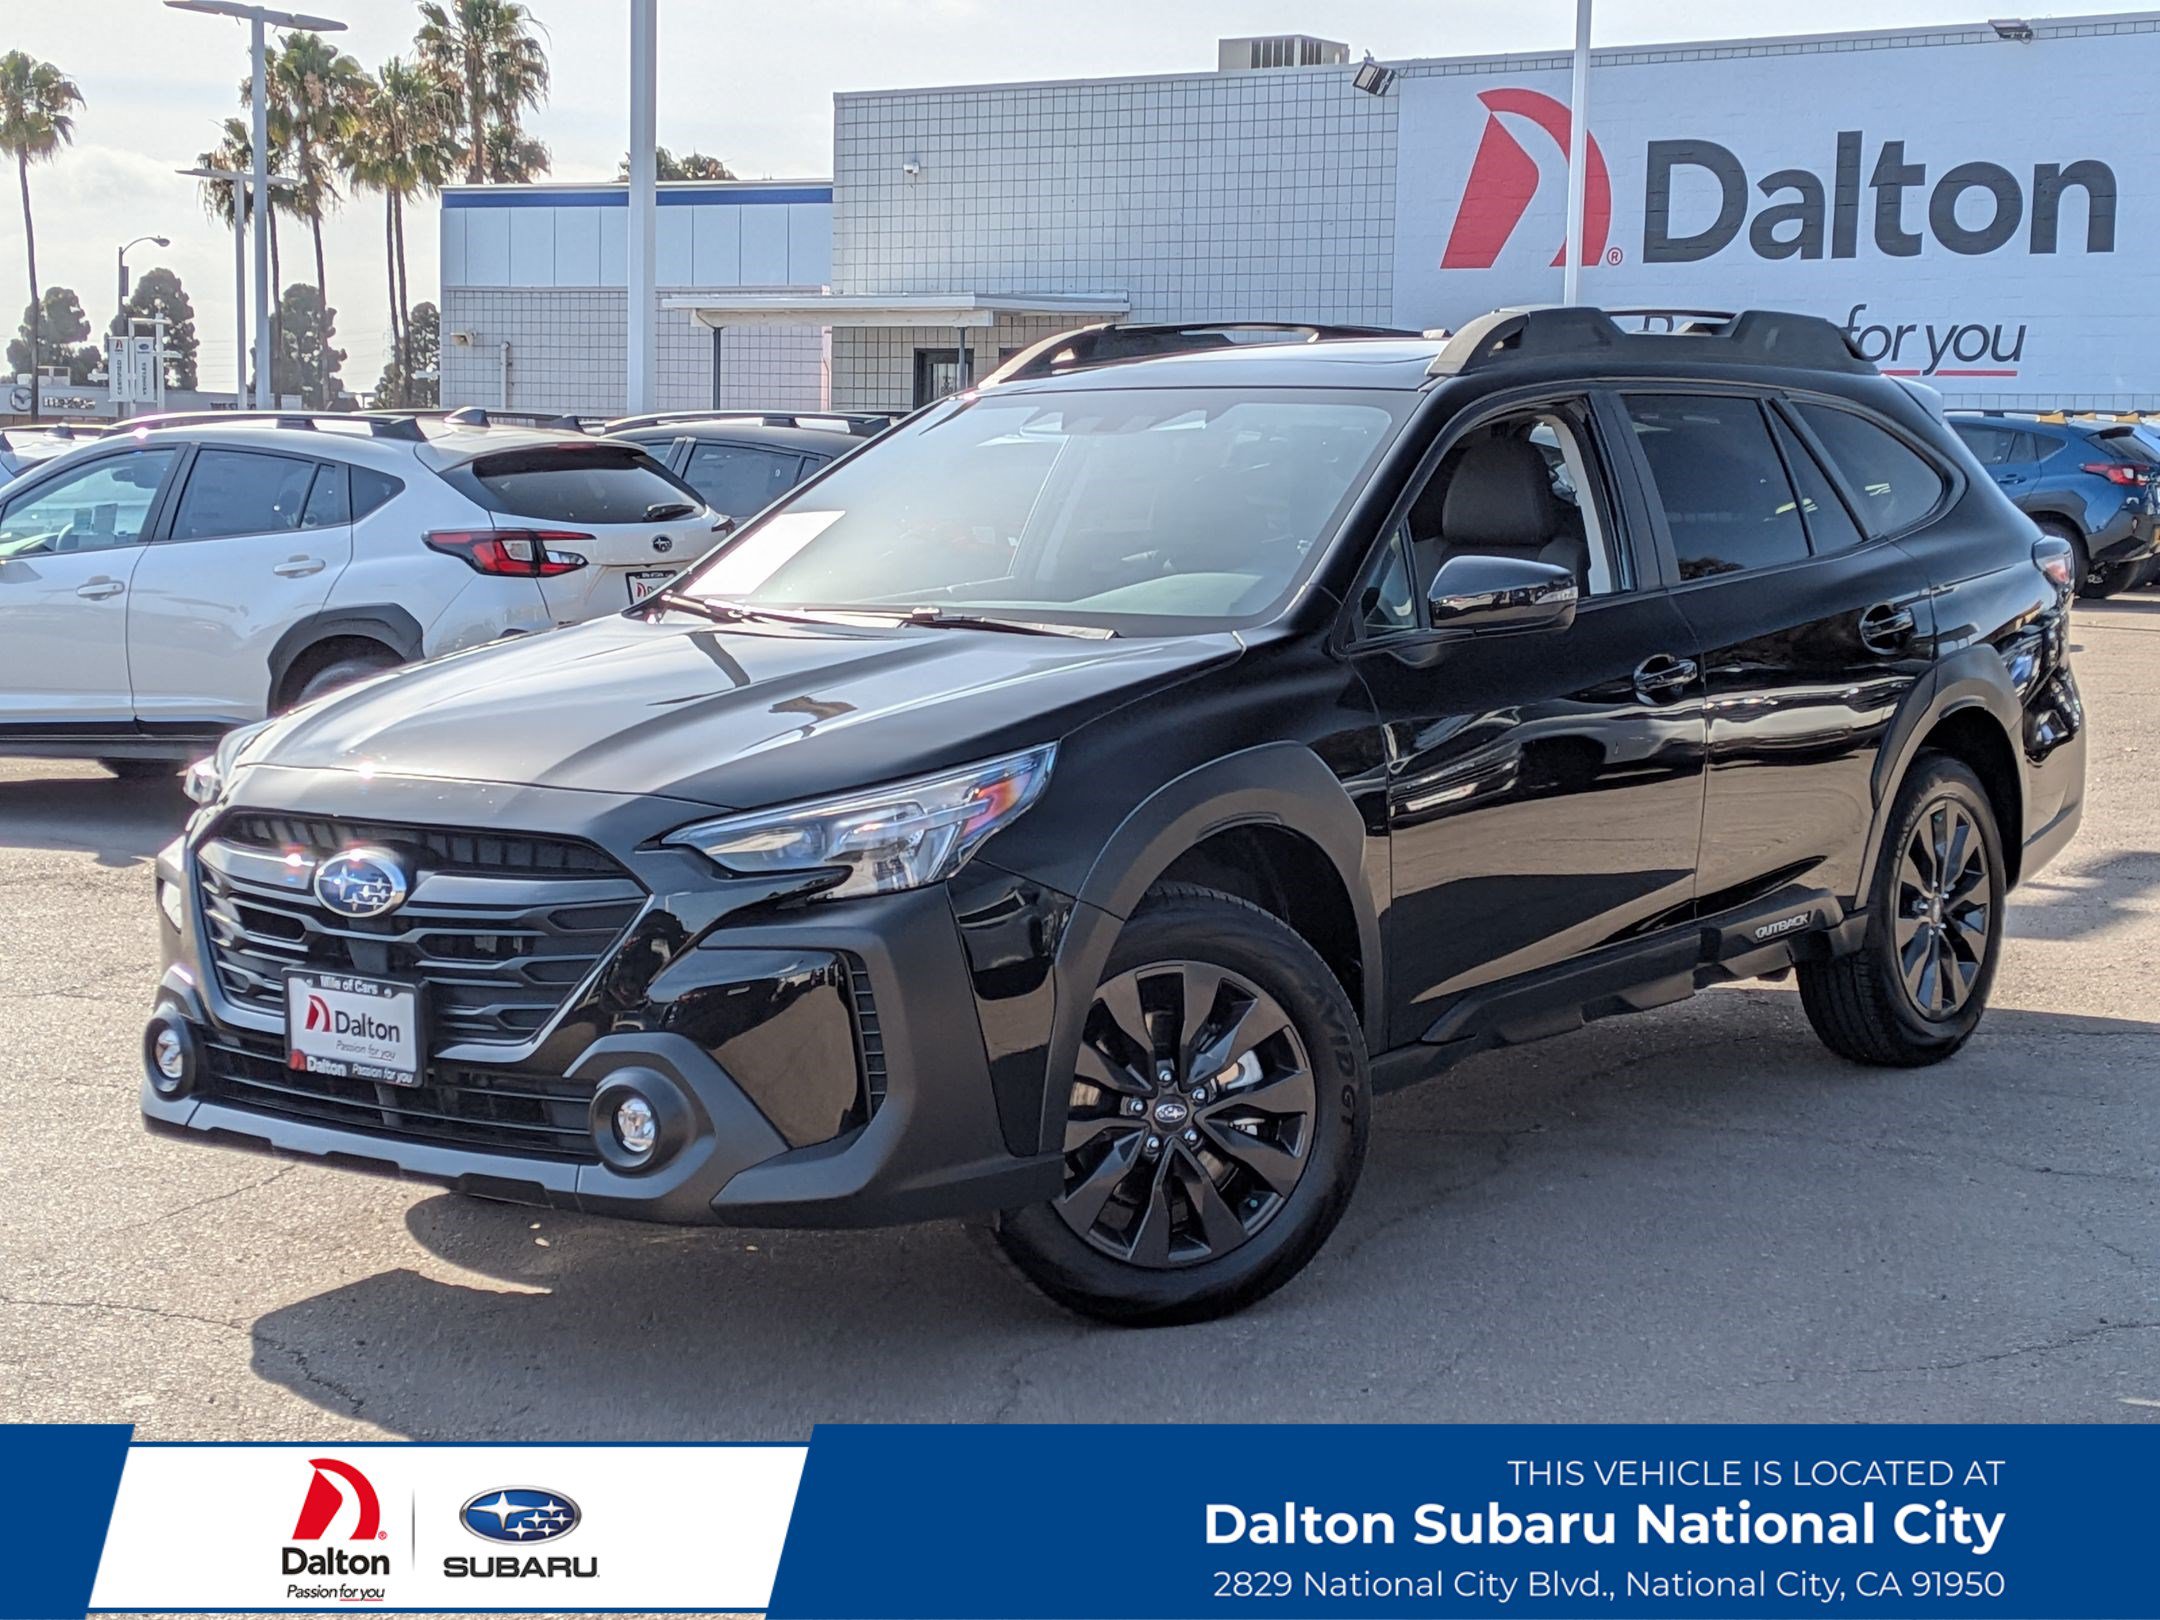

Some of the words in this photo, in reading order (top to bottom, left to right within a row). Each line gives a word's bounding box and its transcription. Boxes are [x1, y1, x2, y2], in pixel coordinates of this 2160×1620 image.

[1642, 130, 2117, 264] Dalton
[1843, 303, 1917, 363] for
[1922, 323, 2028, 376] you
[1755, 914, 1808, 939] OUTBACK
[320, 975, 341, 990] Mile
[342, 979, 354, 992] of
[355, 980, 378, 995] Cars
[335, 1010, 400, 1043] Dalton
[336, 1040, 366, 1054] Passion
[367, 1044, 380, 1056] for
[380, 1047, 396, 1060] you
[306, 1055, 348, 1077] Dalton
[352, 1063, 383, 1078] Passion
[384, 1067, 397, 1080] for
[397, 1071, 414, 1084] you
